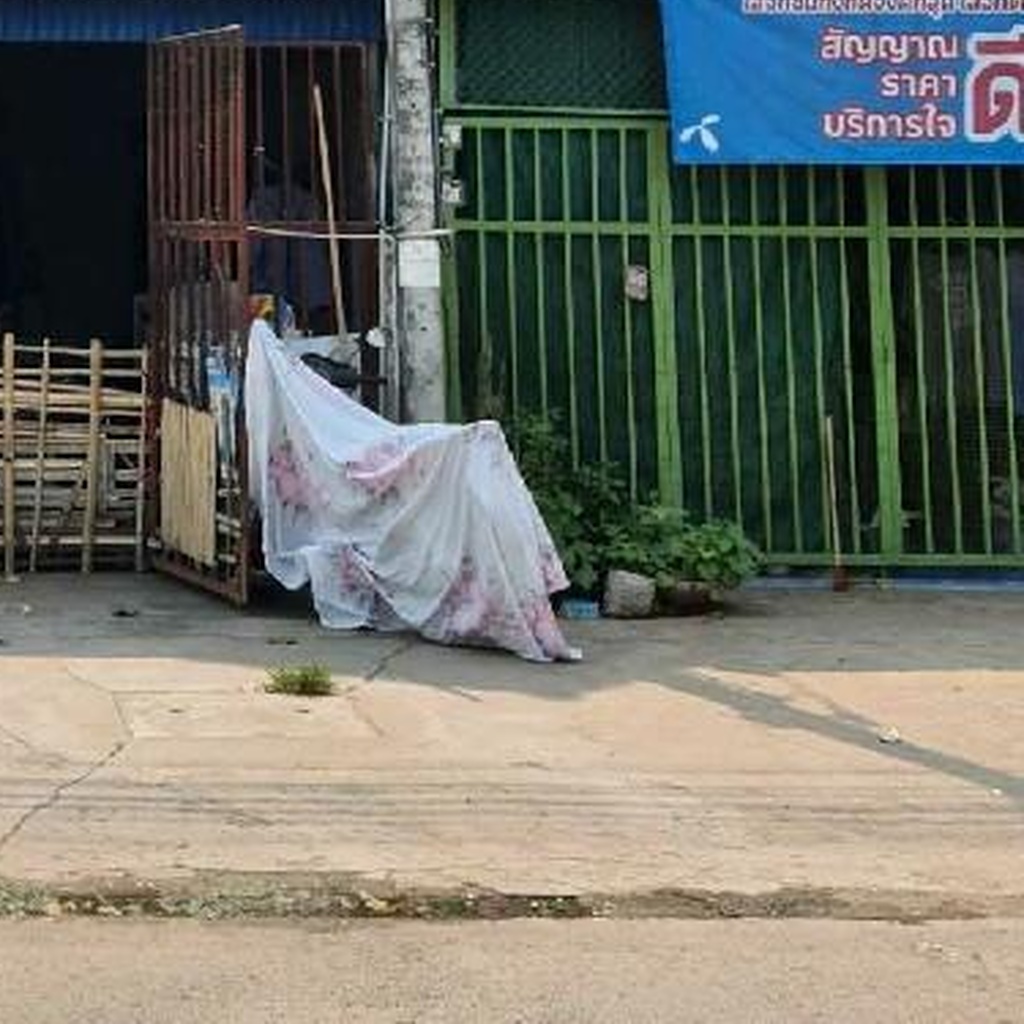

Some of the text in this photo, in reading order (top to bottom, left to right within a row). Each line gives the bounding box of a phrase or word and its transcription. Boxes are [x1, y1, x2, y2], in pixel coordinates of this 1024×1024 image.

[820, 29, 959, 64] สัญญาณ
[881, 74, 957, 97] ราคา
[823, 105, 957, 139] บริการใจ
